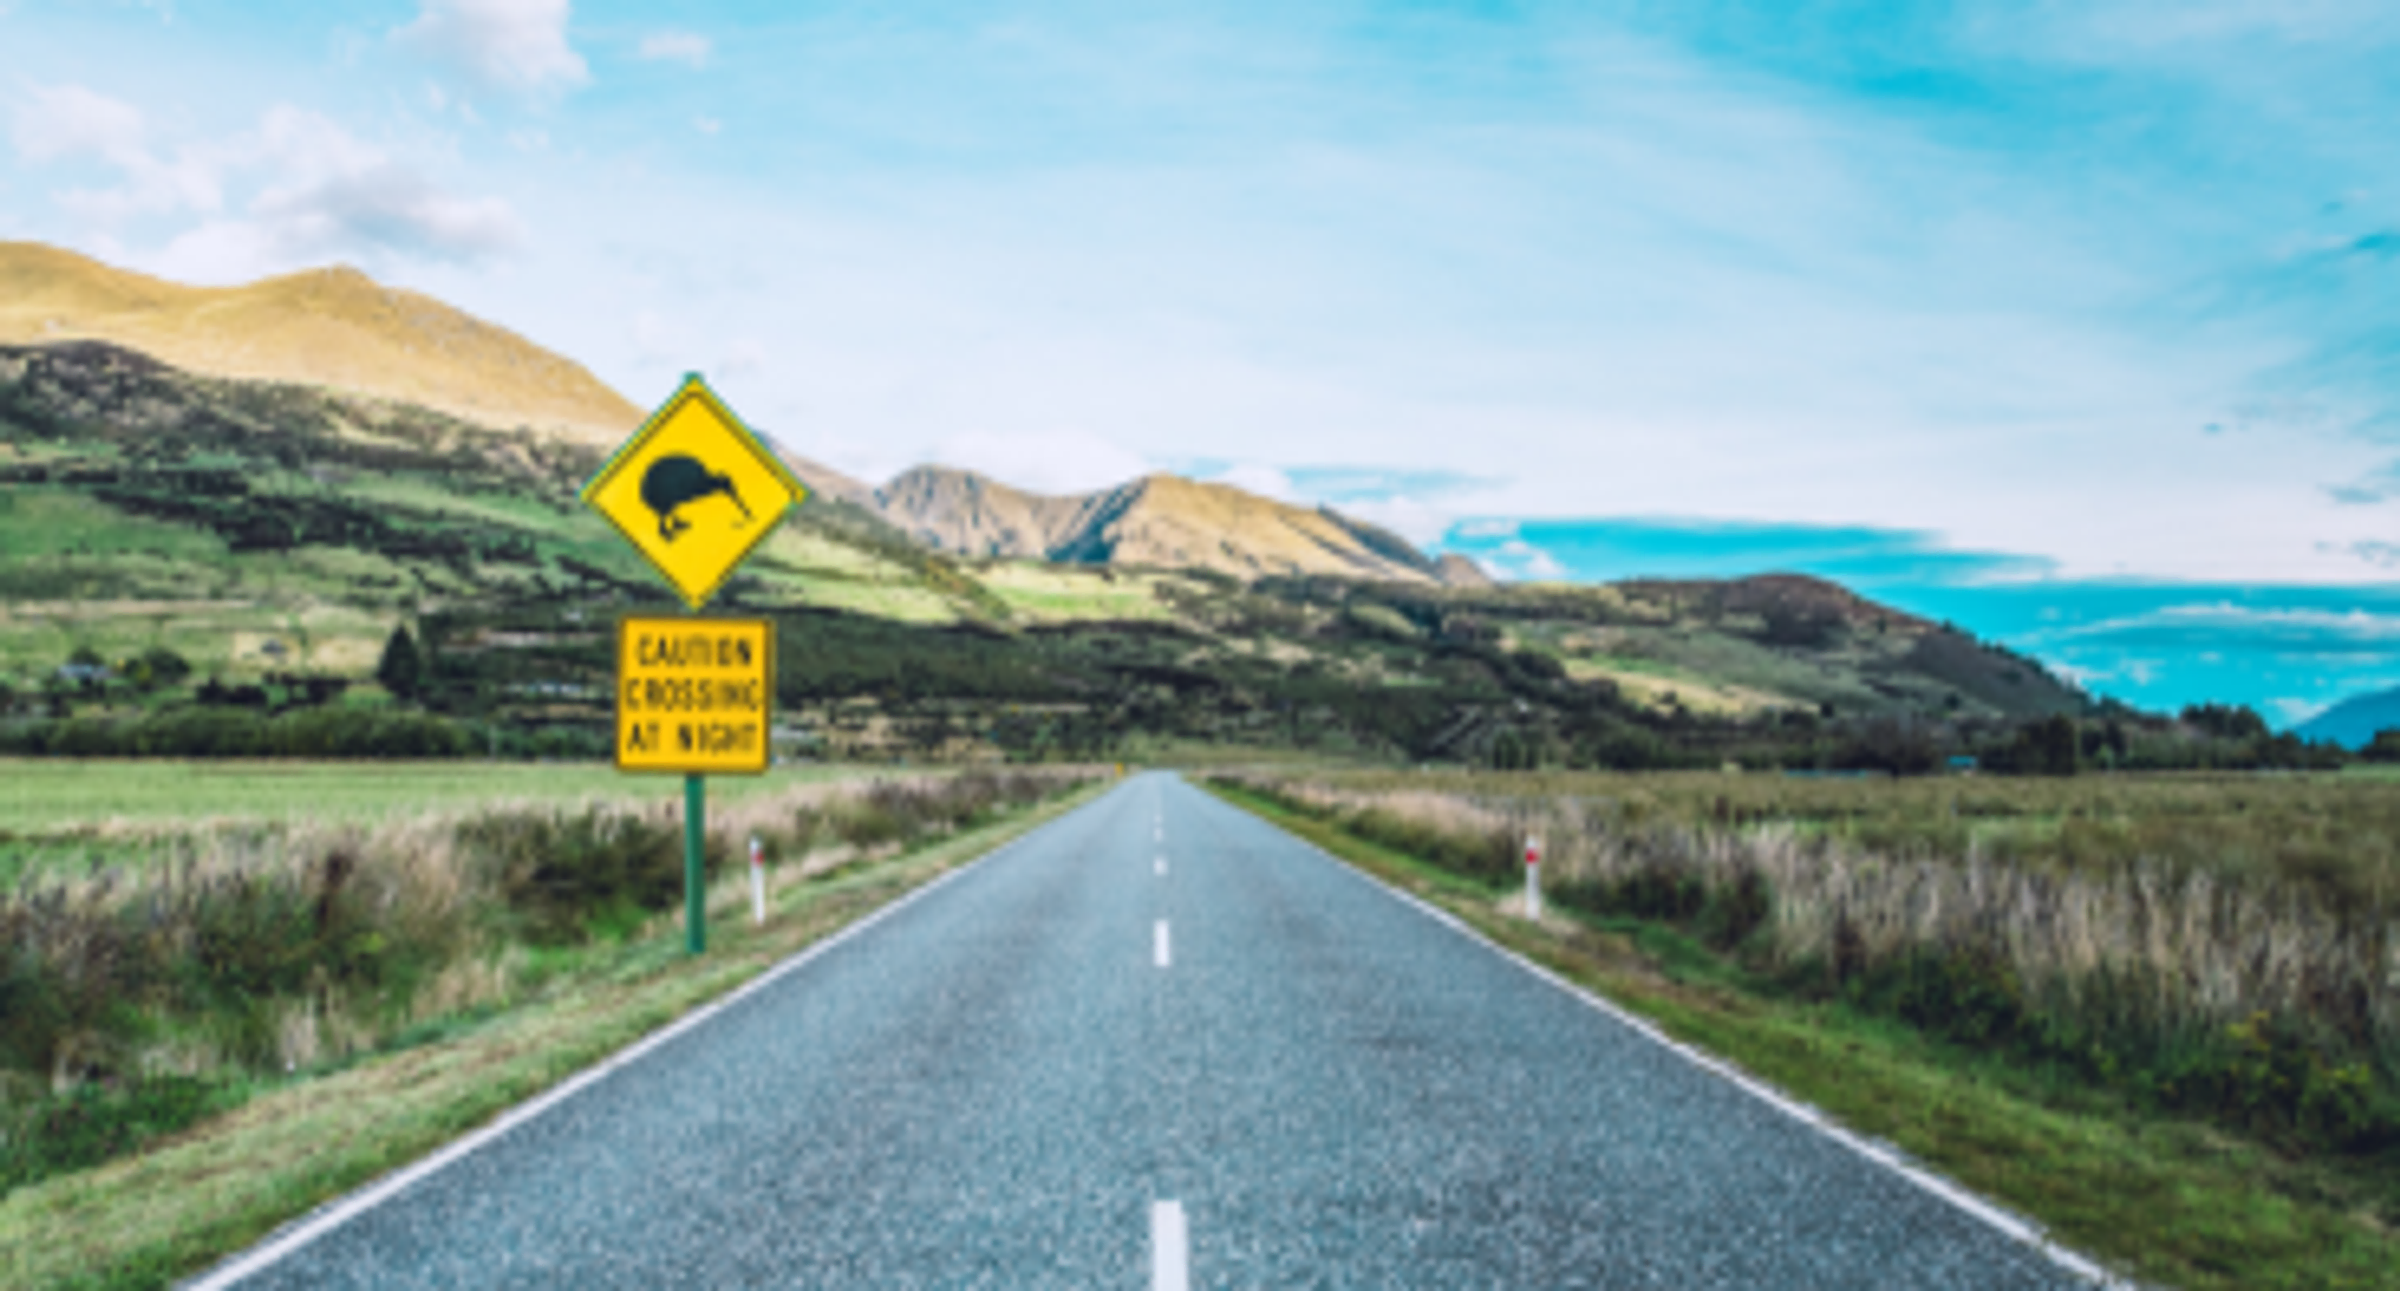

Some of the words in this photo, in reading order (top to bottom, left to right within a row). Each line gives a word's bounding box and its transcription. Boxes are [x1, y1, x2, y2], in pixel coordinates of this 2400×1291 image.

[638, 635, 752, 667] CAUTION
[628, 723, 660, 751] AT
[678, 723, 757, 754] NIGHT
